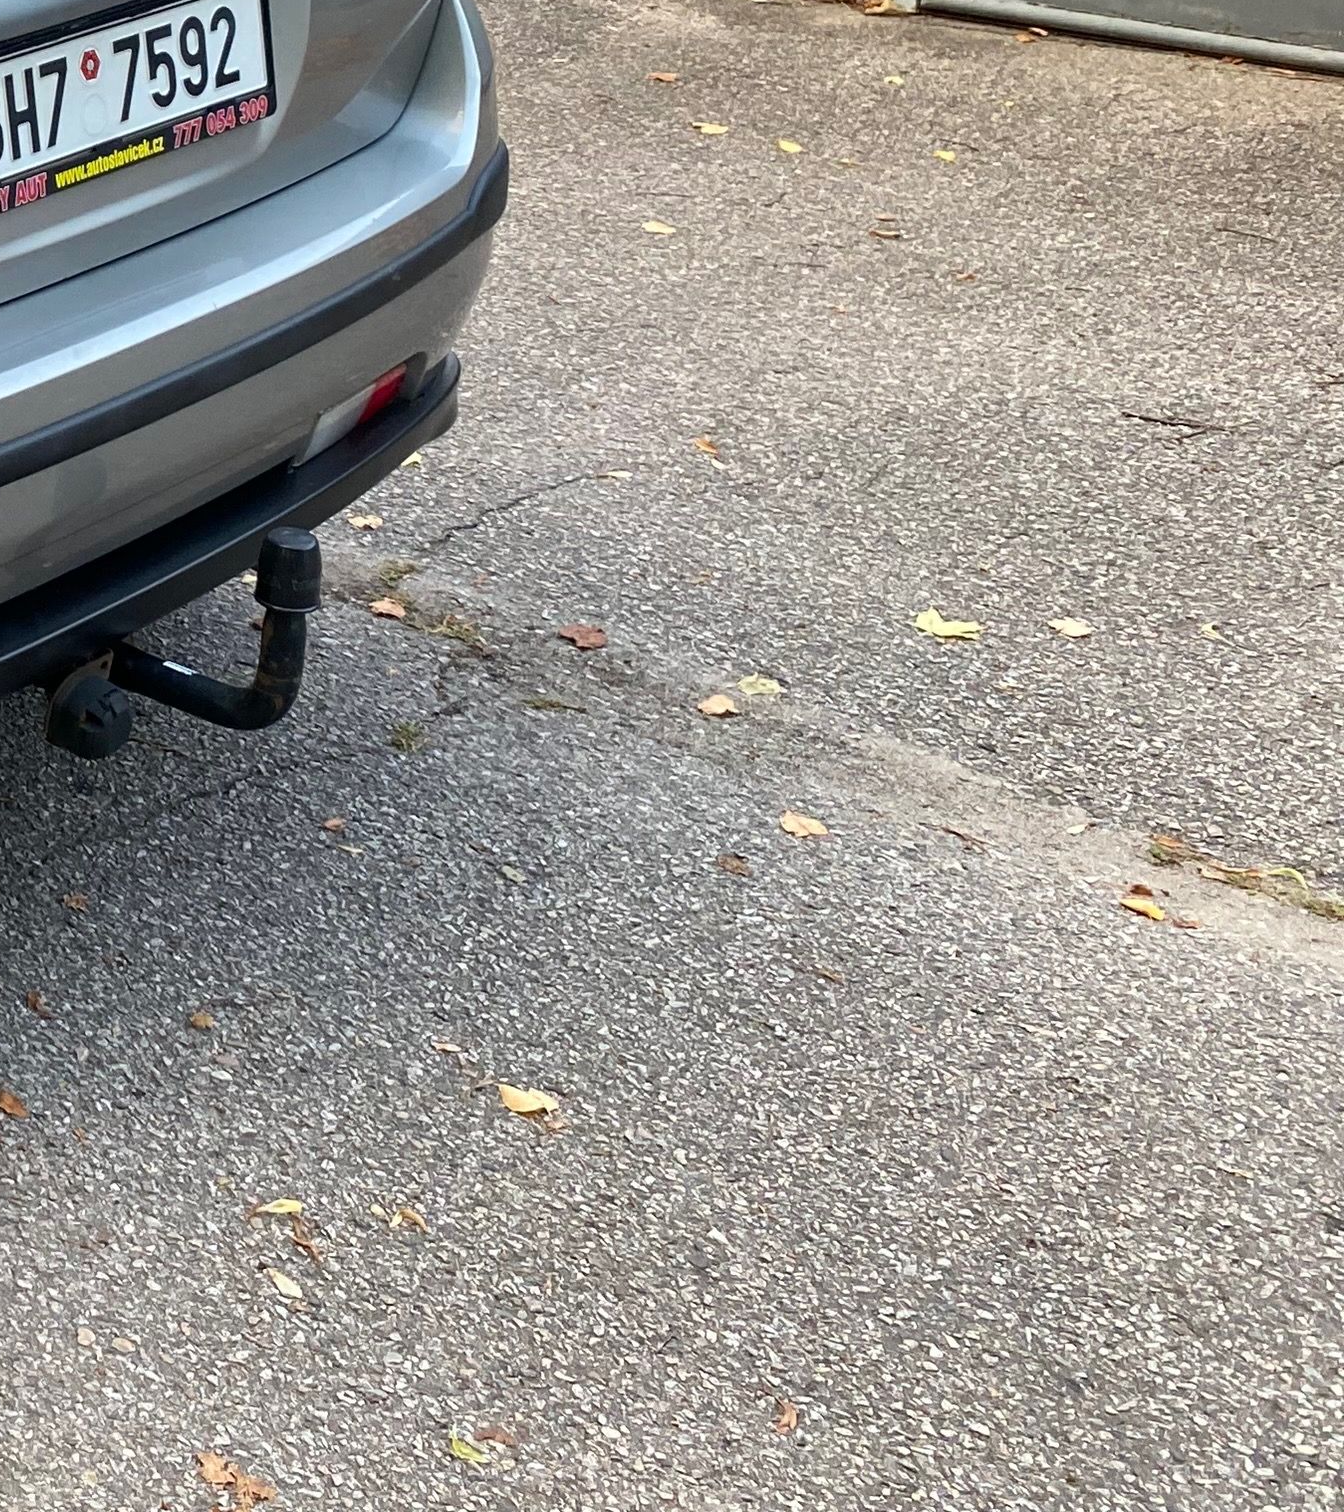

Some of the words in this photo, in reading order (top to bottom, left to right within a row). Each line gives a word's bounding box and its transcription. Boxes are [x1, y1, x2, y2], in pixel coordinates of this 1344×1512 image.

[112, 5, 241, 124] 7592
[14, 172, 48, 207] AUT
[172, 116, 204, 150] 777
[205, 104, 236, 137] 054
[238, 94, 269, 125] 309
